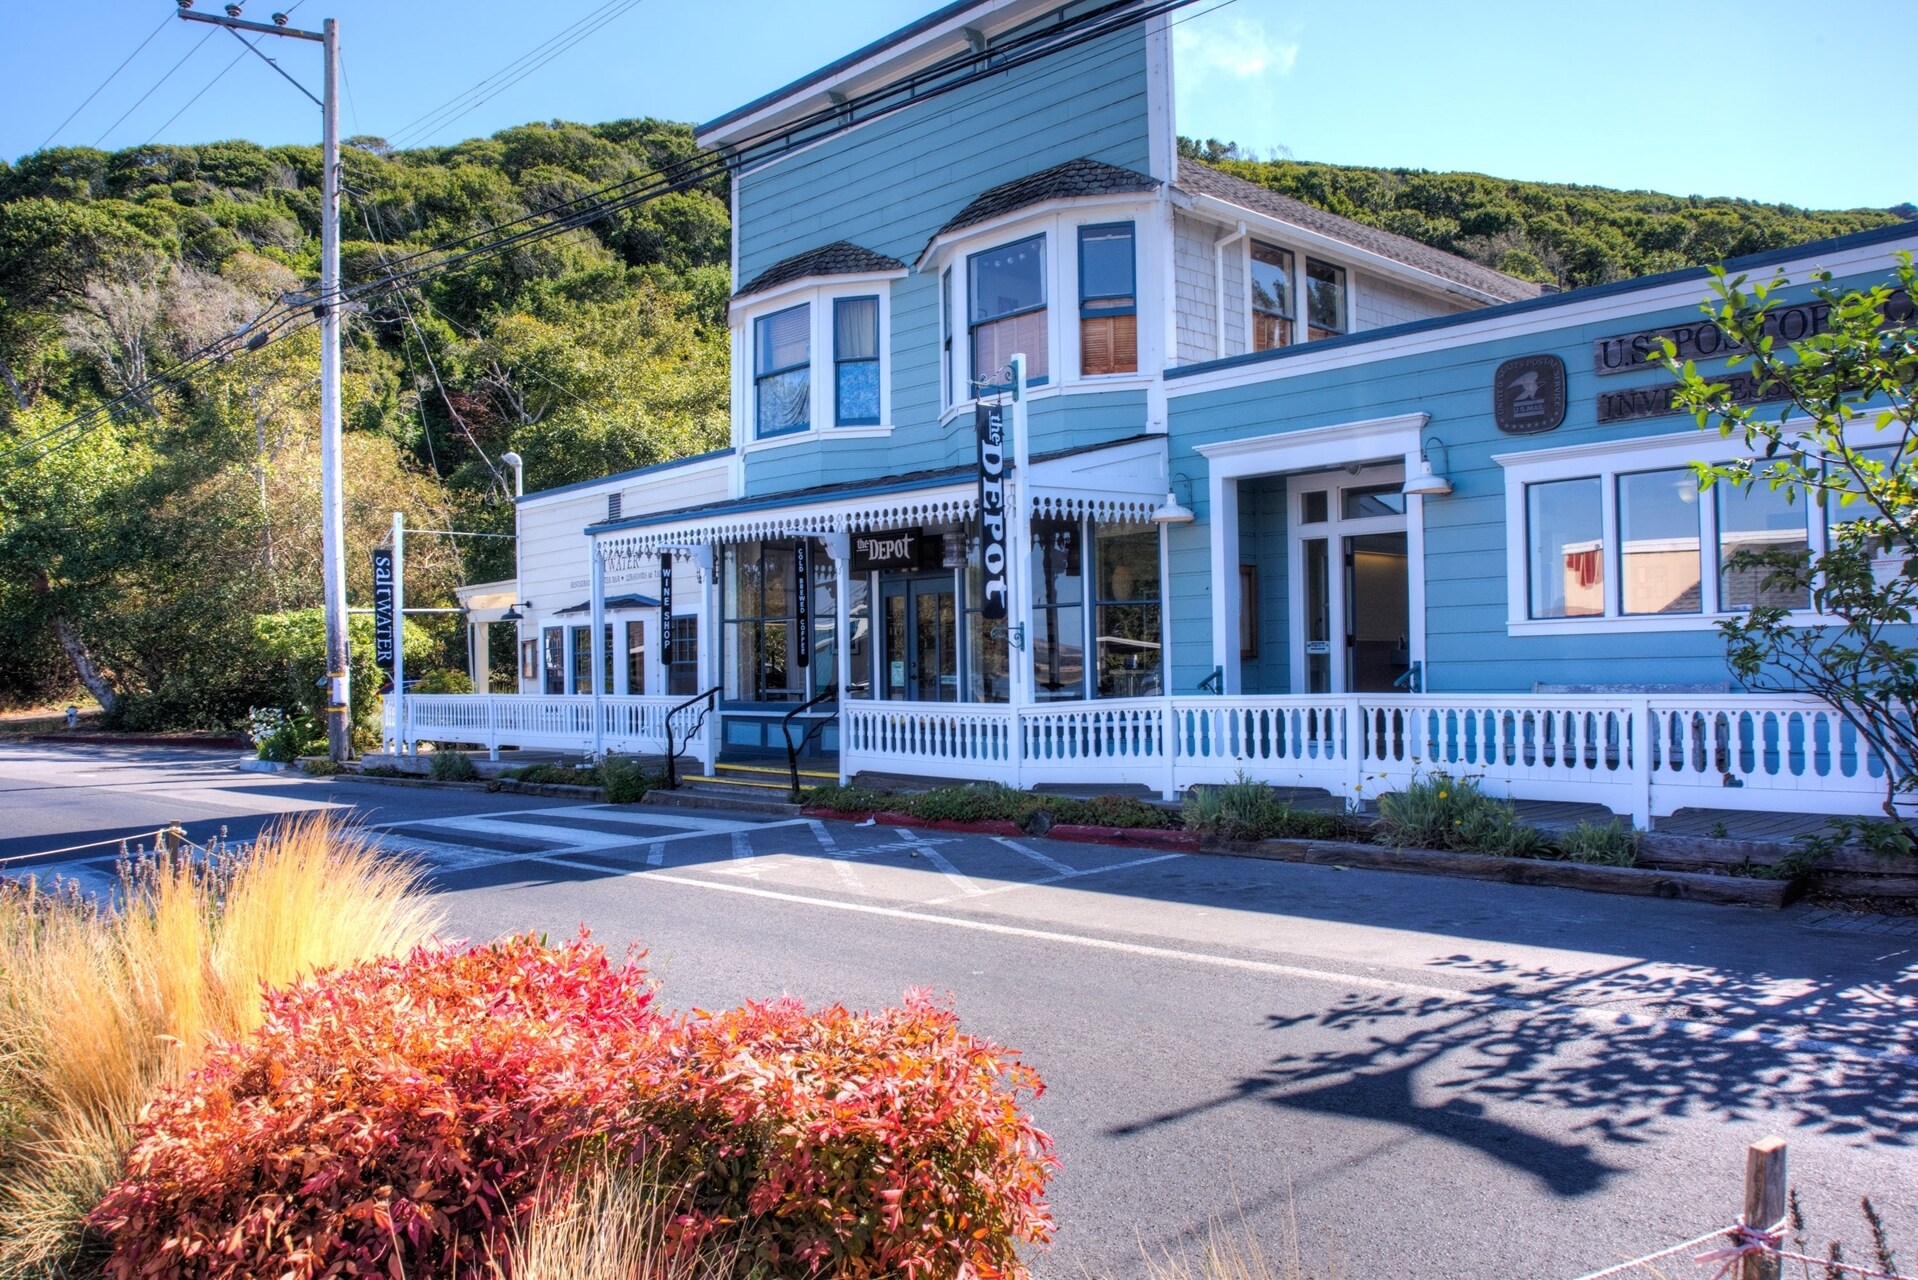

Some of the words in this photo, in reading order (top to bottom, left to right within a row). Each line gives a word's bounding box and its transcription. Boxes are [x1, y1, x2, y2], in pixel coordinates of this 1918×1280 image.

[990, 414, 1002, 446] the
[857, 538, 869, 550] the
[662, 569, 671, 606] WINE
[375, 556, 394, 661] saltWATER
[663, 612, 671, 648] SHOP
